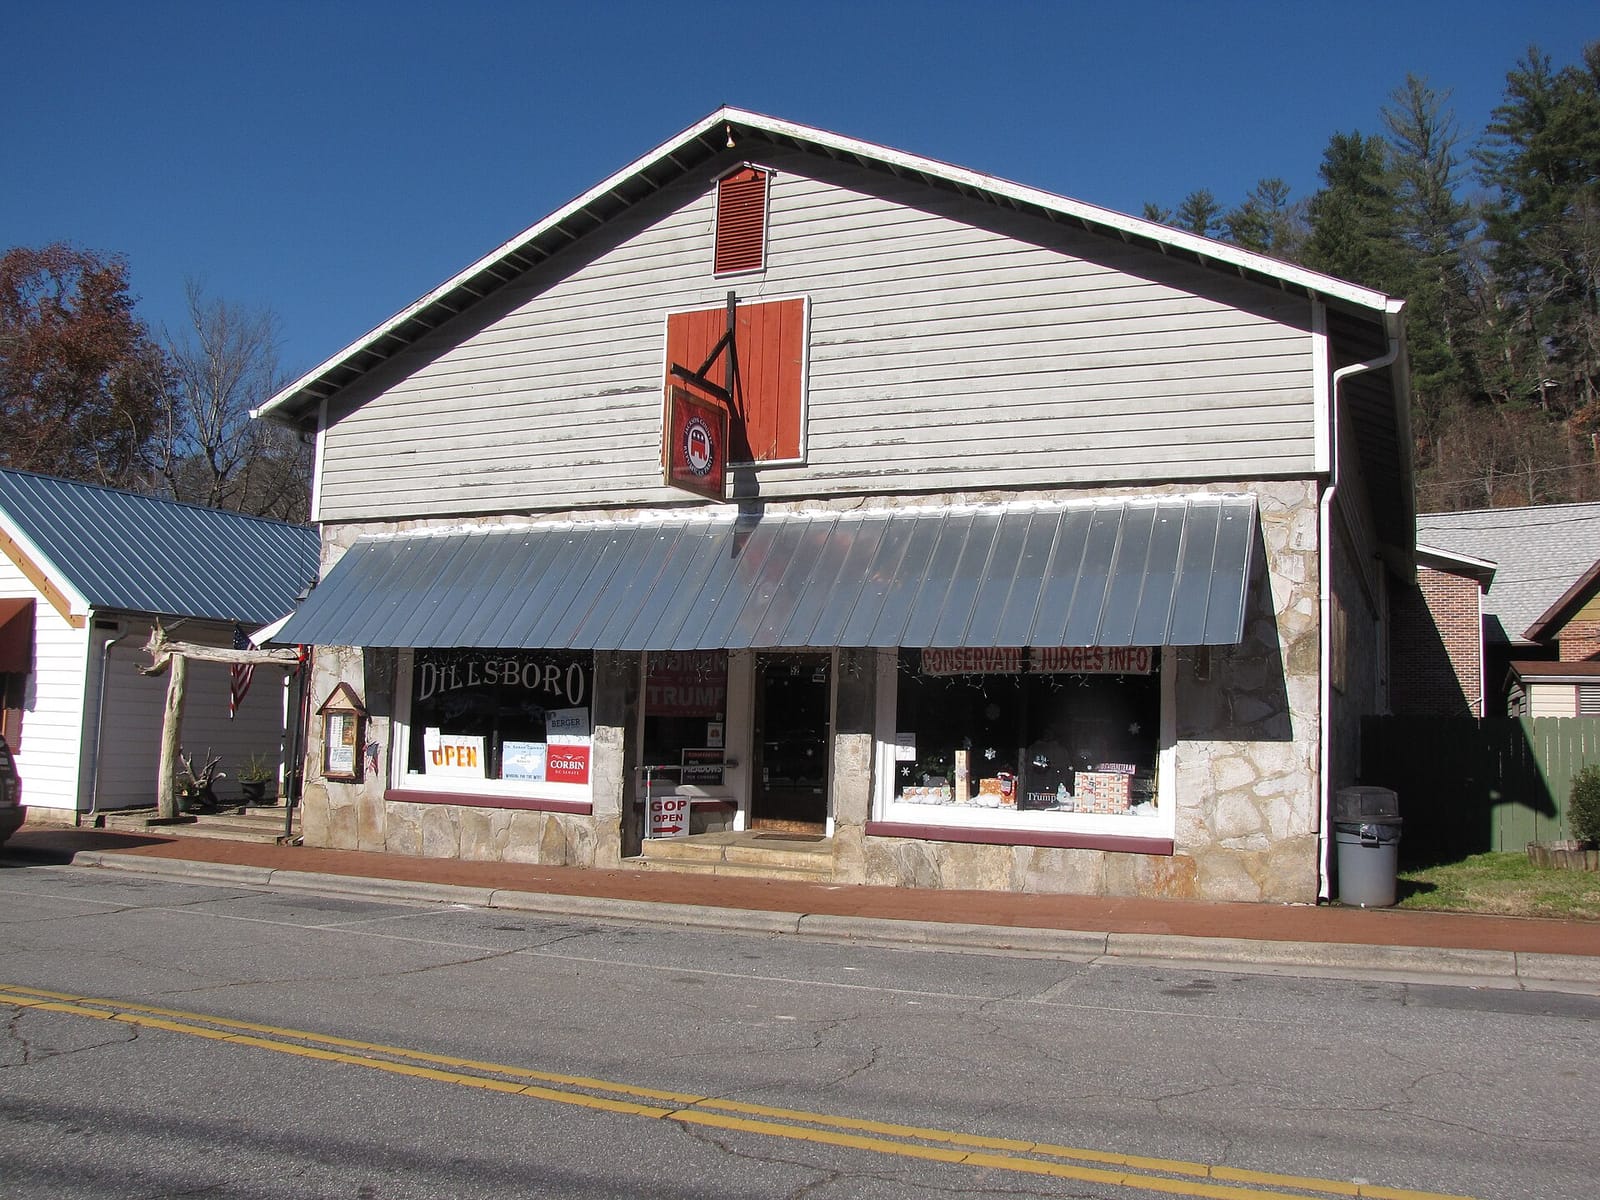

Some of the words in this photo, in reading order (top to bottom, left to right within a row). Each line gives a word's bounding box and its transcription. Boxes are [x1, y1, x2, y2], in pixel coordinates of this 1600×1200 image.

[1041, 646, 1104, 671] JUDGES
[1109, 646, 1148, 671] INFO
[419, 660, 585, 705] DILLSBORO
[647, 686, 725, 706] TRUMP
[551, 718, 581, 728] BERGER
[432, 744, 477, 768] OPEN
[550, 760, 585, 770] CORBIN
[651, 800, 688, 812] GOP
[653, 813, 684, 823] OPEN
